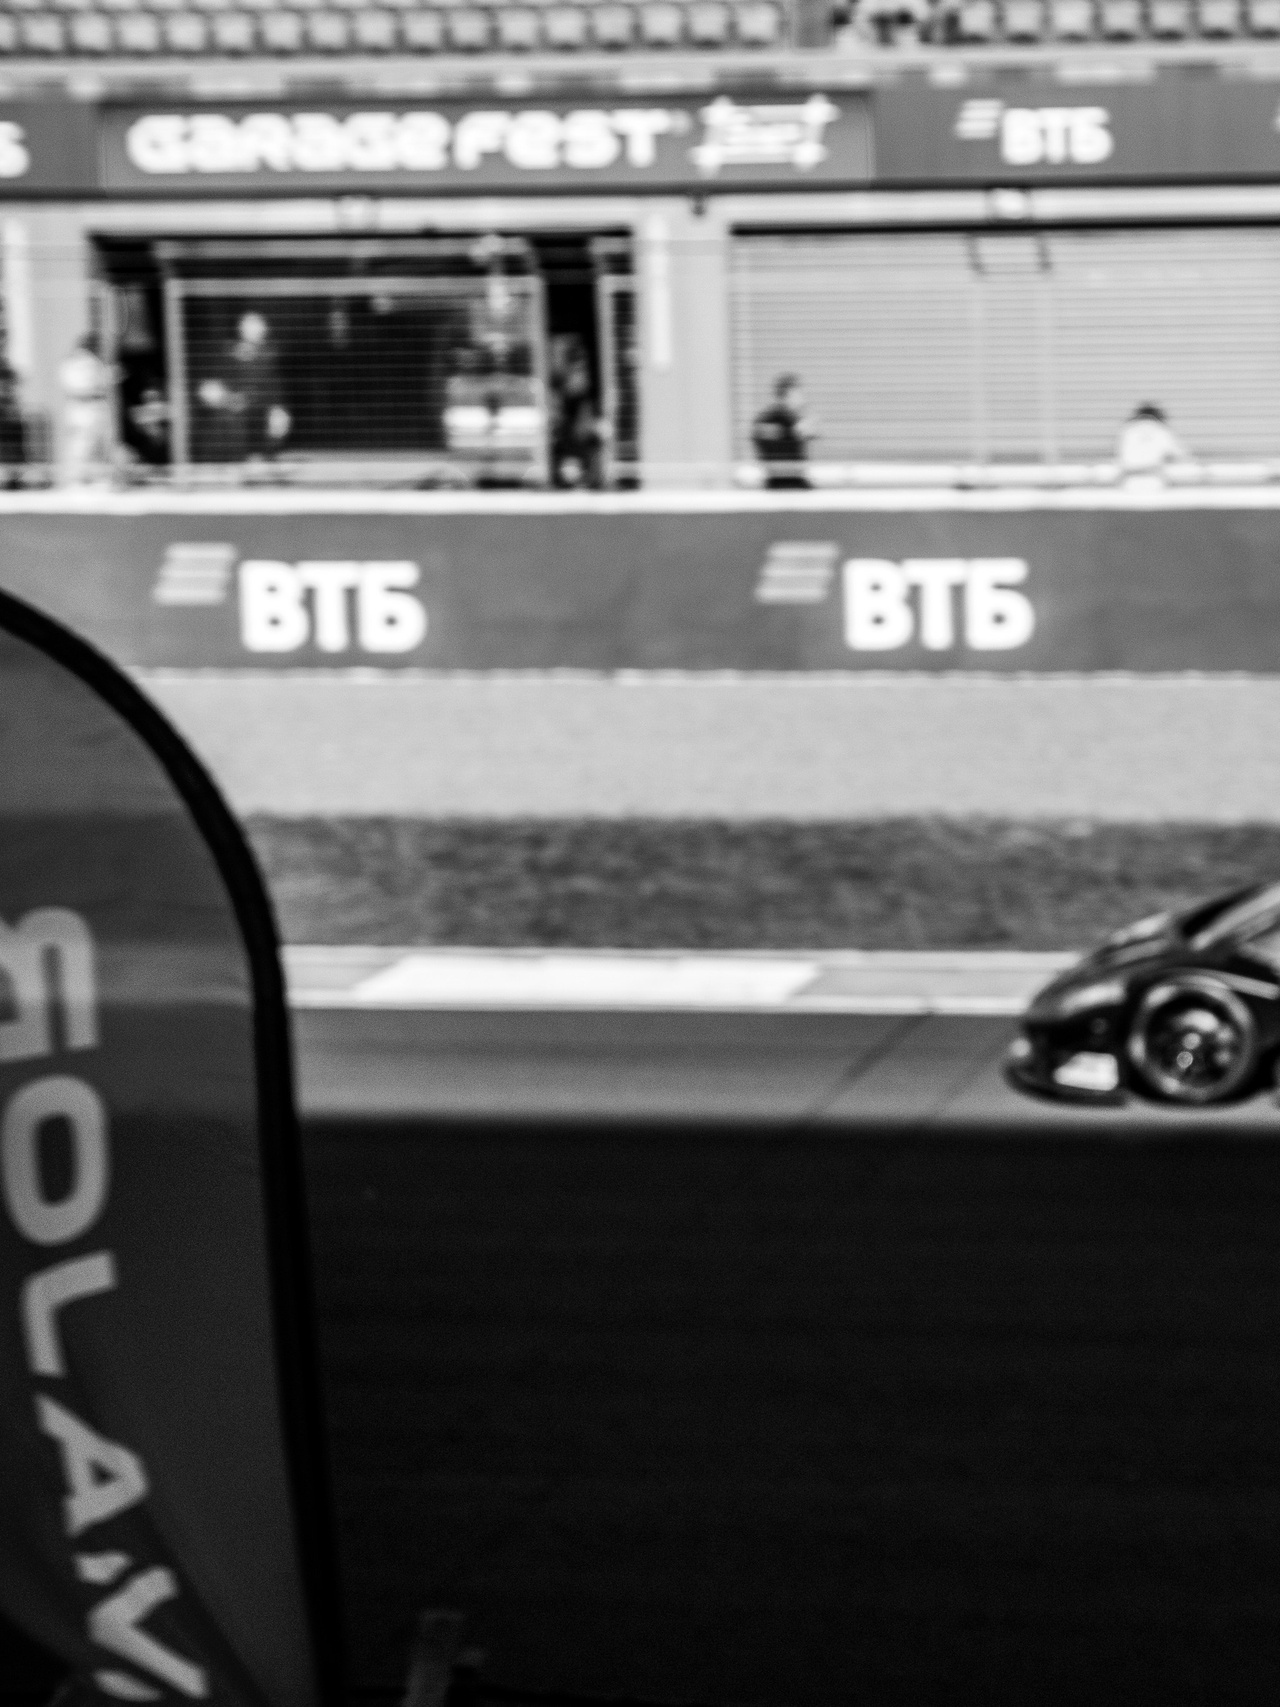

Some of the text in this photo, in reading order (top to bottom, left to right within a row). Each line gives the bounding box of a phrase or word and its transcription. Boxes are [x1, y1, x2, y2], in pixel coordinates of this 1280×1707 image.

[1001, 107, 1111, 164] ВТБ
[240, 561, 425, 652] ВТБ
[844, 559, 1033, 650] ВТБ
